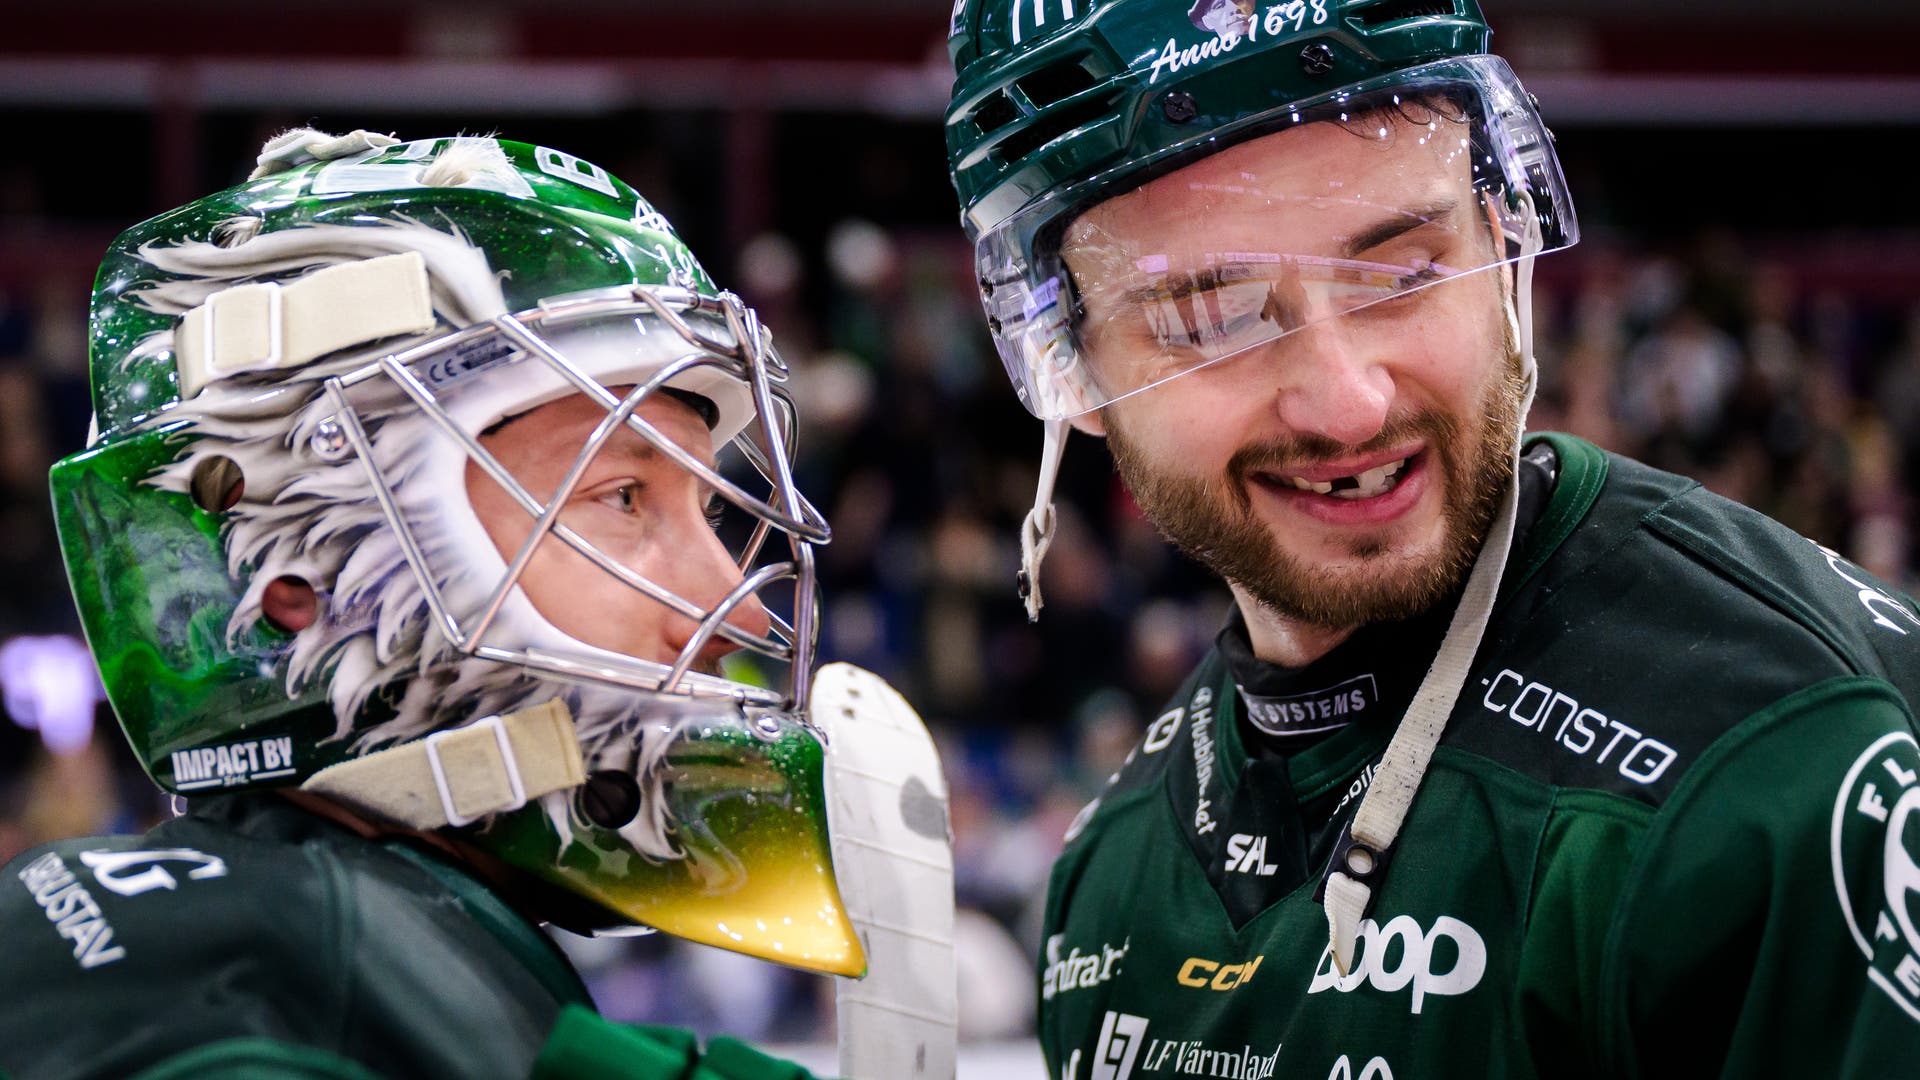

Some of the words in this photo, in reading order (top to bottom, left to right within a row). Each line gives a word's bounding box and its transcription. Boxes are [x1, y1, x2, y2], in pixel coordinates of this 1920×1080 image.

[1149, 32, 1242, 84] Anno
[1248, 0, 1329, 42] 1698
[1264, 689, 1366, 724] SYSTEMS
[171, 741, 259, 783] IMPACT
[261, 736, 292, 770] BY
[1142, 1039, 1178, 1072] LF
